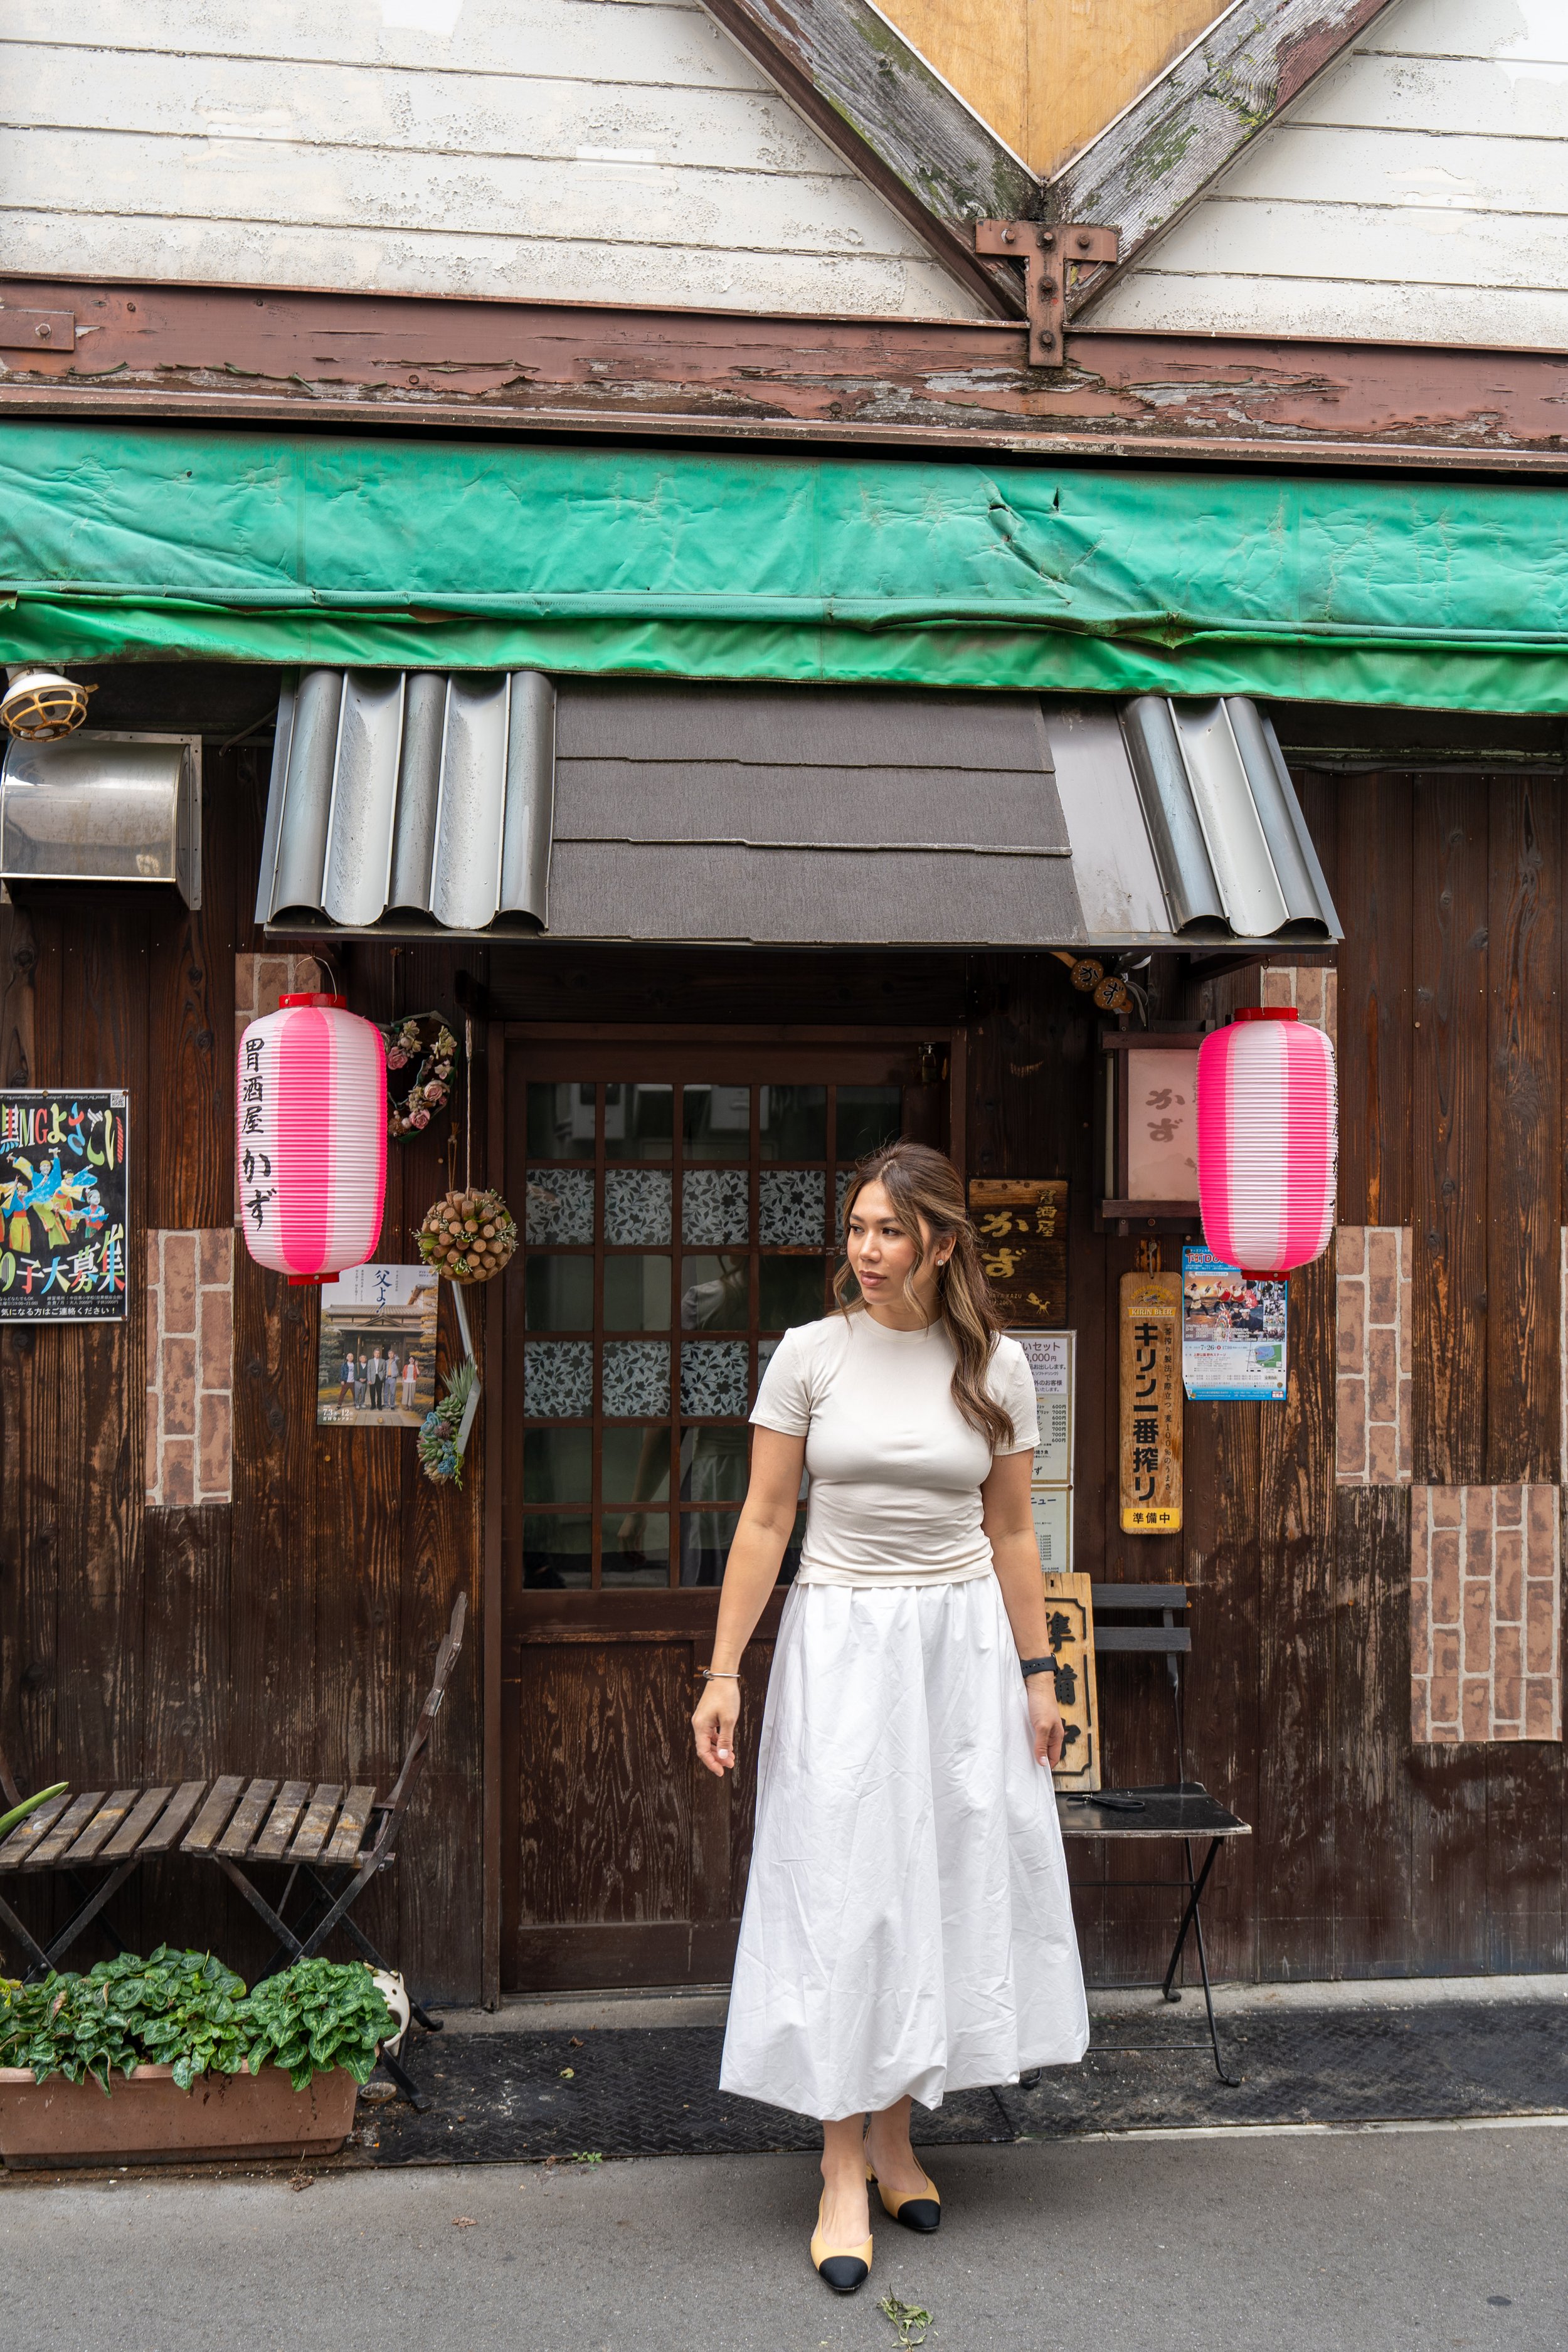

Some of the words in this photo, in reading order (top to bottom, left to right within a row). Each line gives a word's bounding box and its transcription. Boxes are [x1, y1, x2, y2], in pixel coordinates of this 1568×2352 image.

[1079, 966, 1124, 1005] かず
[1145, 1088, 1185, 1143] かず
[979, 1211, 1029, 1278] かず
[1020, 1342, 1061, 1352] いセット
[1133, 1323, 1159, 1502] キリン一番搾り
[1132, 1512, 1170, 1524] 準備中
